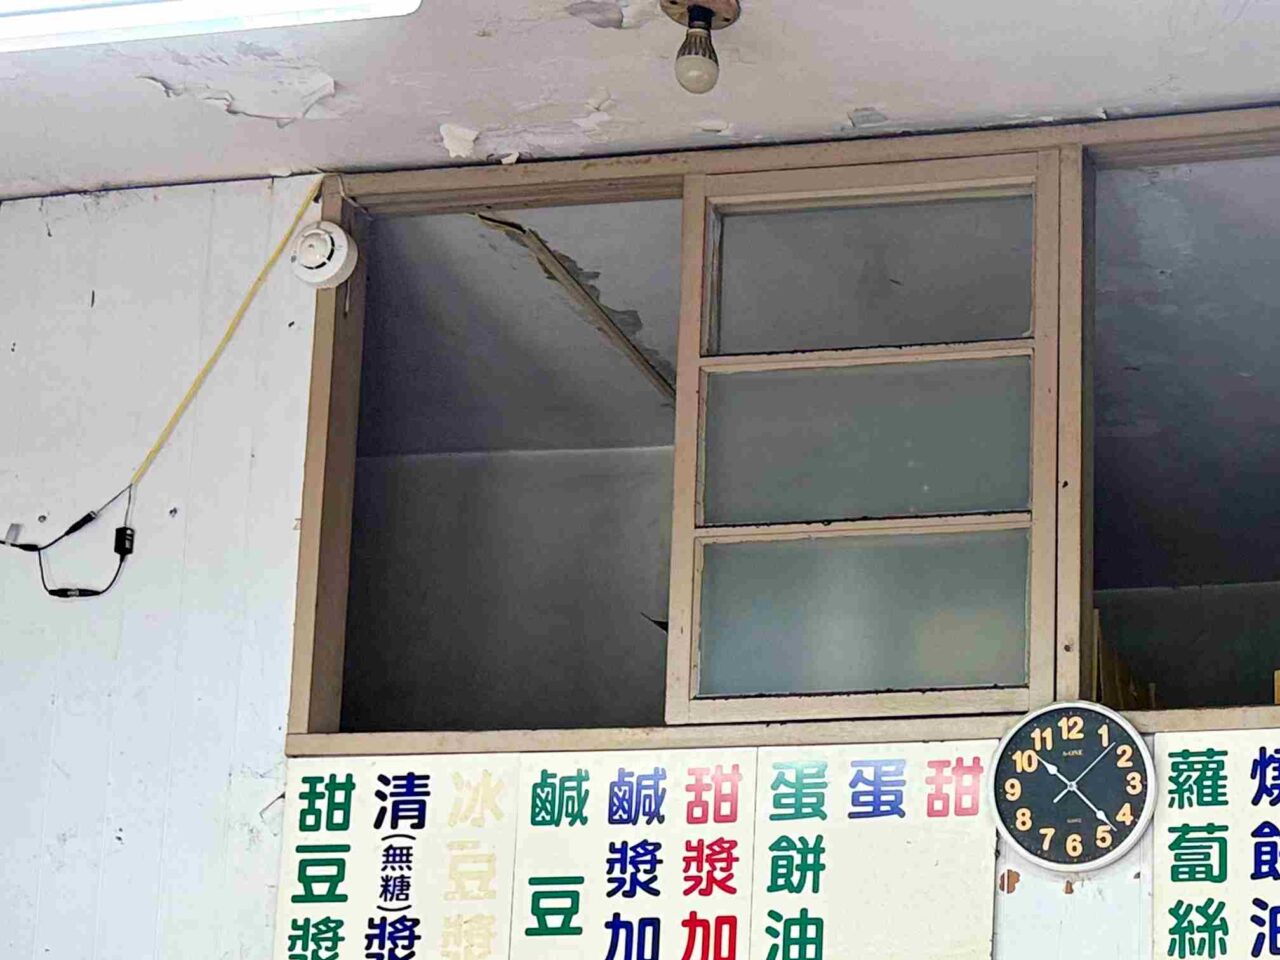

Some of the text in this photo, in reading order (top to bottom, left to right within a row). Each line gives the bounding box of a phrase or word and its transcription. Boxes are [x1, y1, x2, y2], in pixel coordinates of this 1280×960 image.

[1030, 727, 1053, 750] 11
[1057, 716, 1084, 740] 12
[1097, 724, 1109, 748] 1
[1012, 749, 1038, 773] 10
[1116, 744, 1133, 768] 2
[1004, 778, 1022, 802] 9
[1126, 771, 1143, 796] 3
[1015, 808, 1033, 831] 8
[1115, 802, 1134, 826] 4
[1039, 827, 1056, 851] 7
[1065, 833, 1083, 858] 6
[1095, 825, 1112, 849] 5
[1167, 747, 1230, 960] 蘿蔔絲
